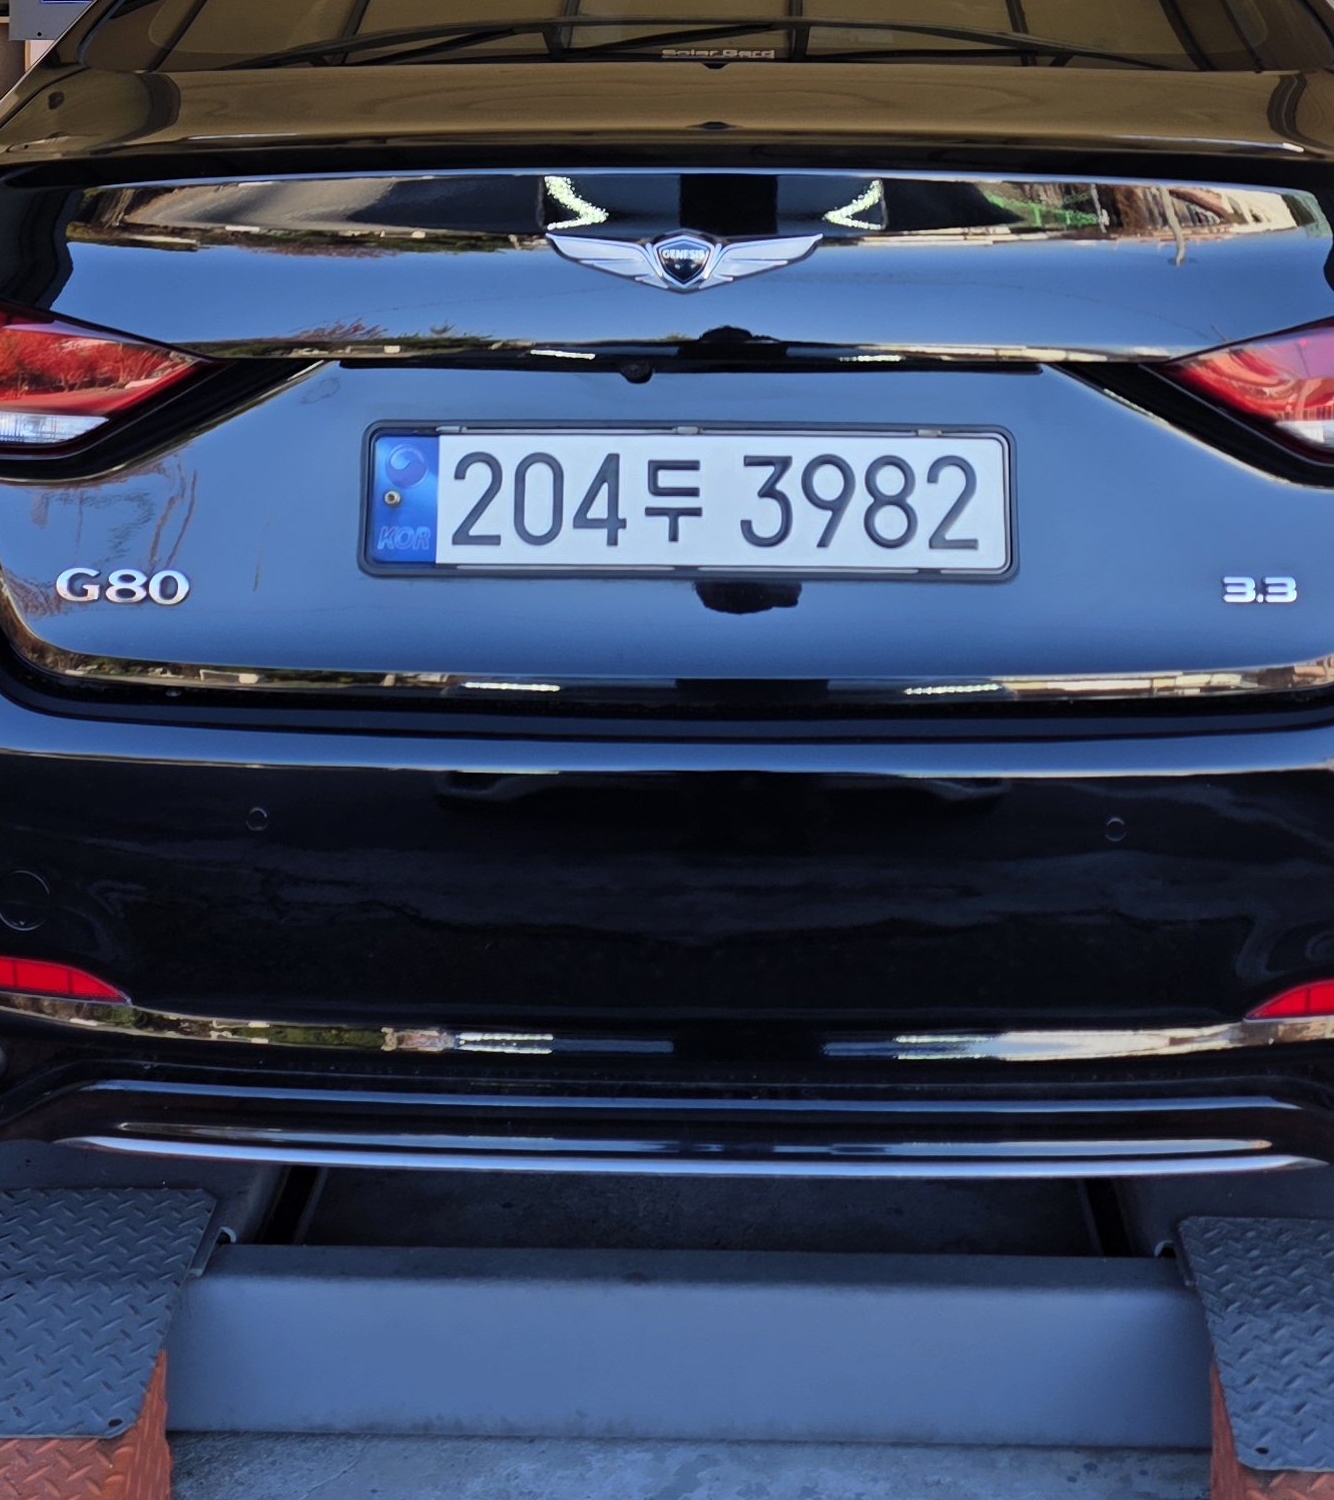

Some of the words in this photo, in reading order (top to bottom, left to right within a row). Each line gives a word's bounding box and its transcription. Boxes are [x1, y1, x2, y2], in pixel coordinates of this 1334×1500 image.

[661, 49, 719, 59] Solar
[722, 49, 775, 59] Gard
[662, 248, 705, 260] GENESIS
[450, 451, 704, 547] 204두
[739, 454, 980, 550] 3982
[377, 525, 432, 551] KOR
[55, 566, 191, 606] G80
[1221, 575, 1298, 604] 3.3
